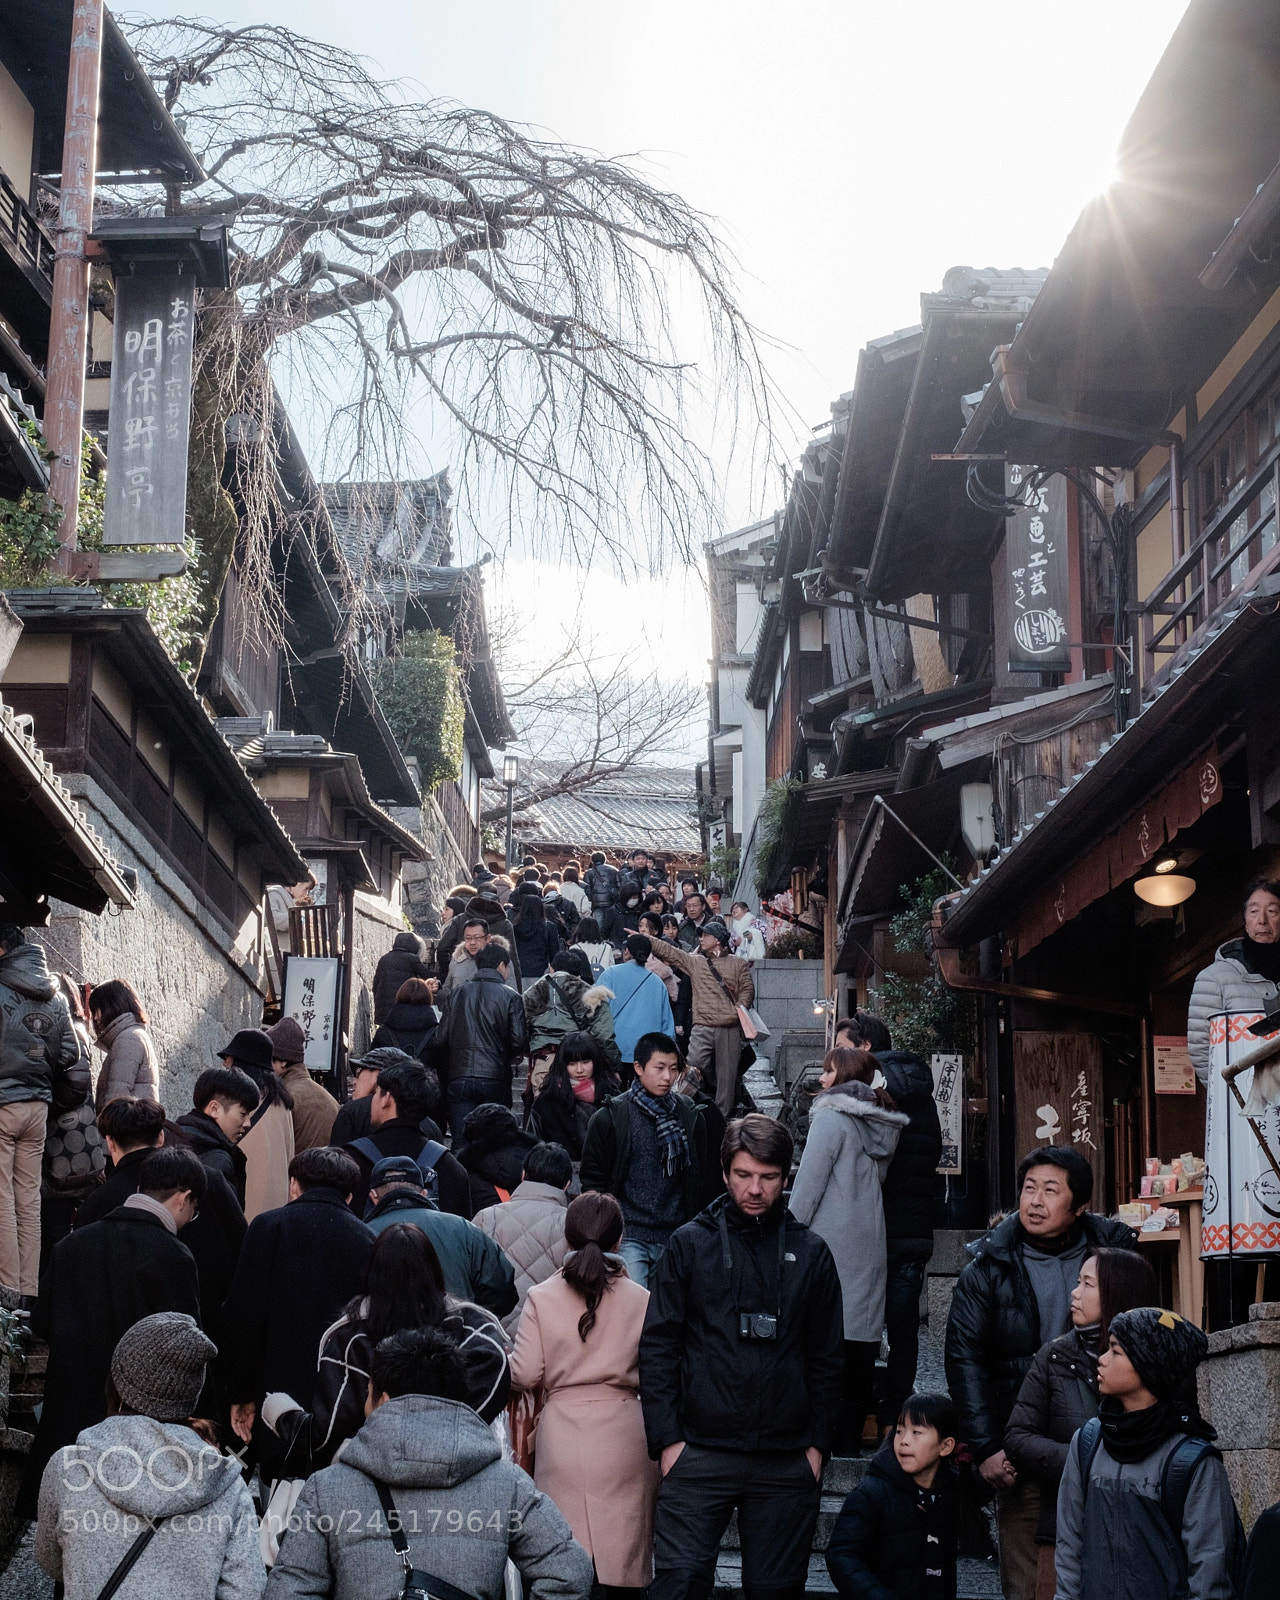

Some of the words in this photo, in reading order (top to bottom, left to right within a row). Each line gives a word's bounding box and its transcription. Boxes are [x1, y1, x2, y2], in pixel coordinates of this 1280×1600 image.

[121, 318, 164, 508] 明保野亭
[1071, 1071, 1097, 1150] 産寧坂
